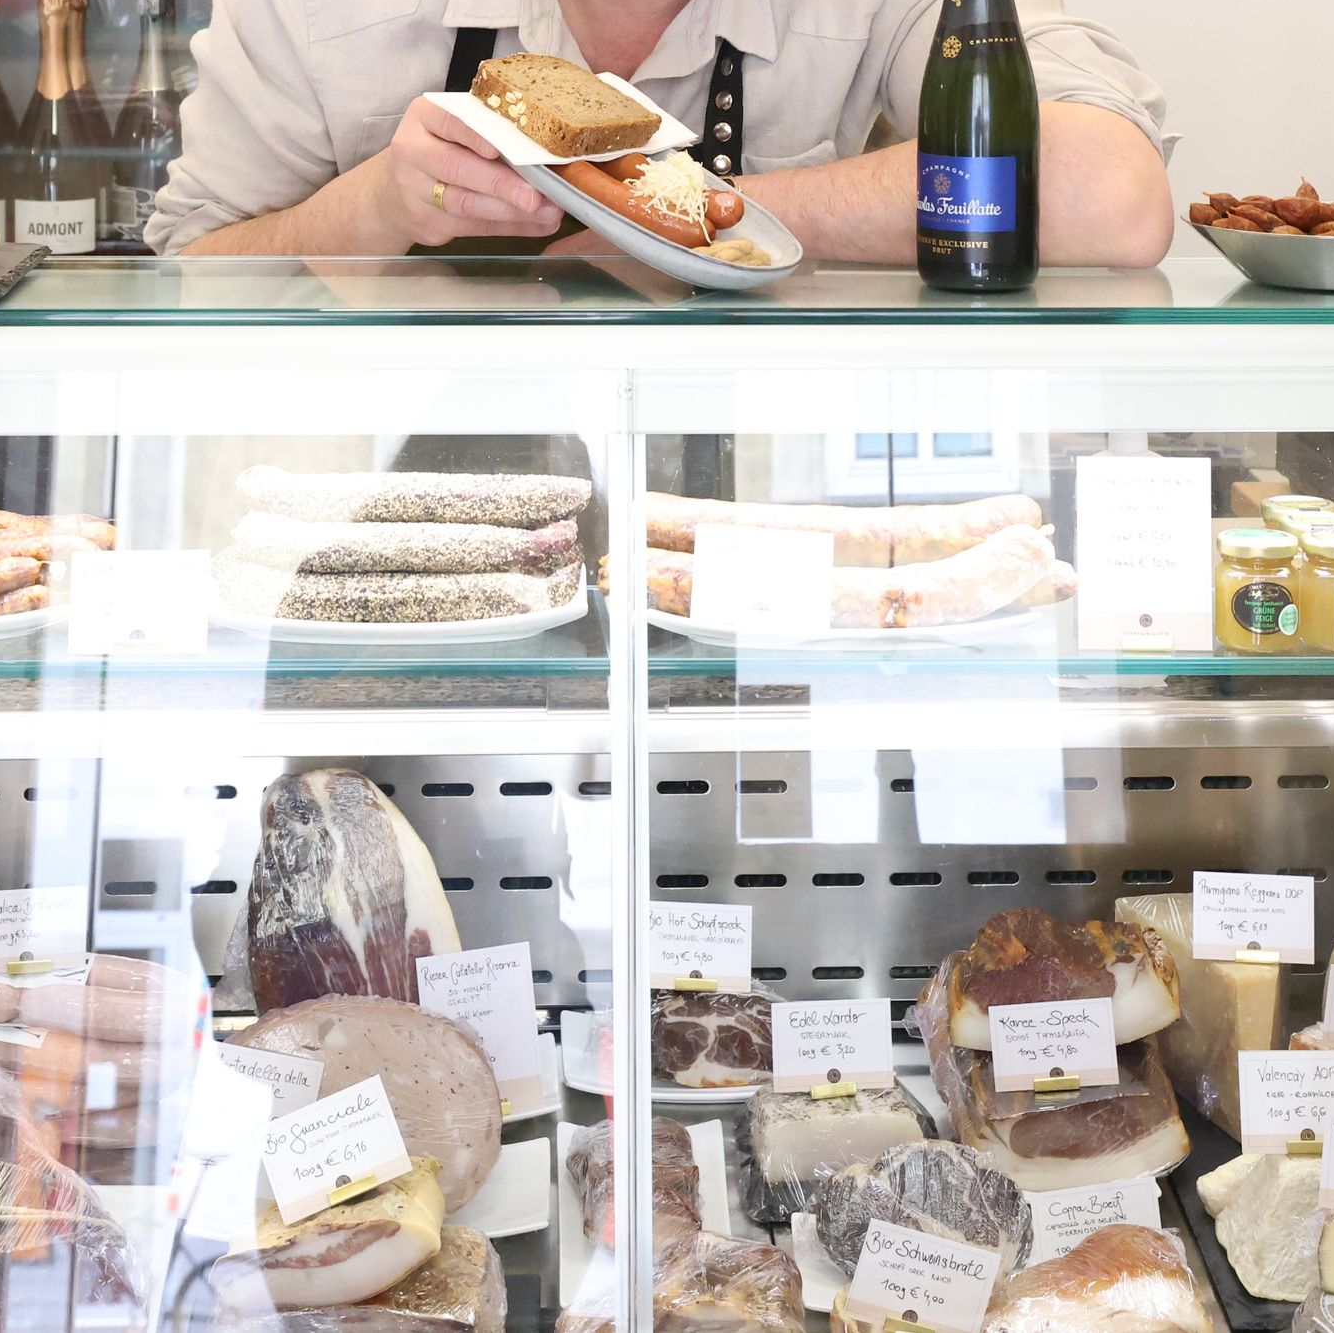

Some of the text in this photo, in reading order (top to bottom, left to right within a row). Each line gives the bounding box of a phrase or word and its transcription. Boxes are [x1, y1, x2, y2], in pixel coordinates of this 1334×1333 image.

[922, 165, 971, 180] CHAMPAGNE
[937, 197, 1002, 216] Feuillatte
[28, 222, 84, 237] ADMONT
[932, 247, 952, 255] BRUT
[939, 239, 989, 249] EXCLUSIVE
[1285, 889, 1303, 898] DOP
[789, 1008, 866, 1028] Edel Lardo
[285, 1070, 311, 1087] della
[265, 1133, 287, 1154] Bio
[1049, 1202, 1087, 1220] Coppa
[866, 1231, 895, 1254] Bio
